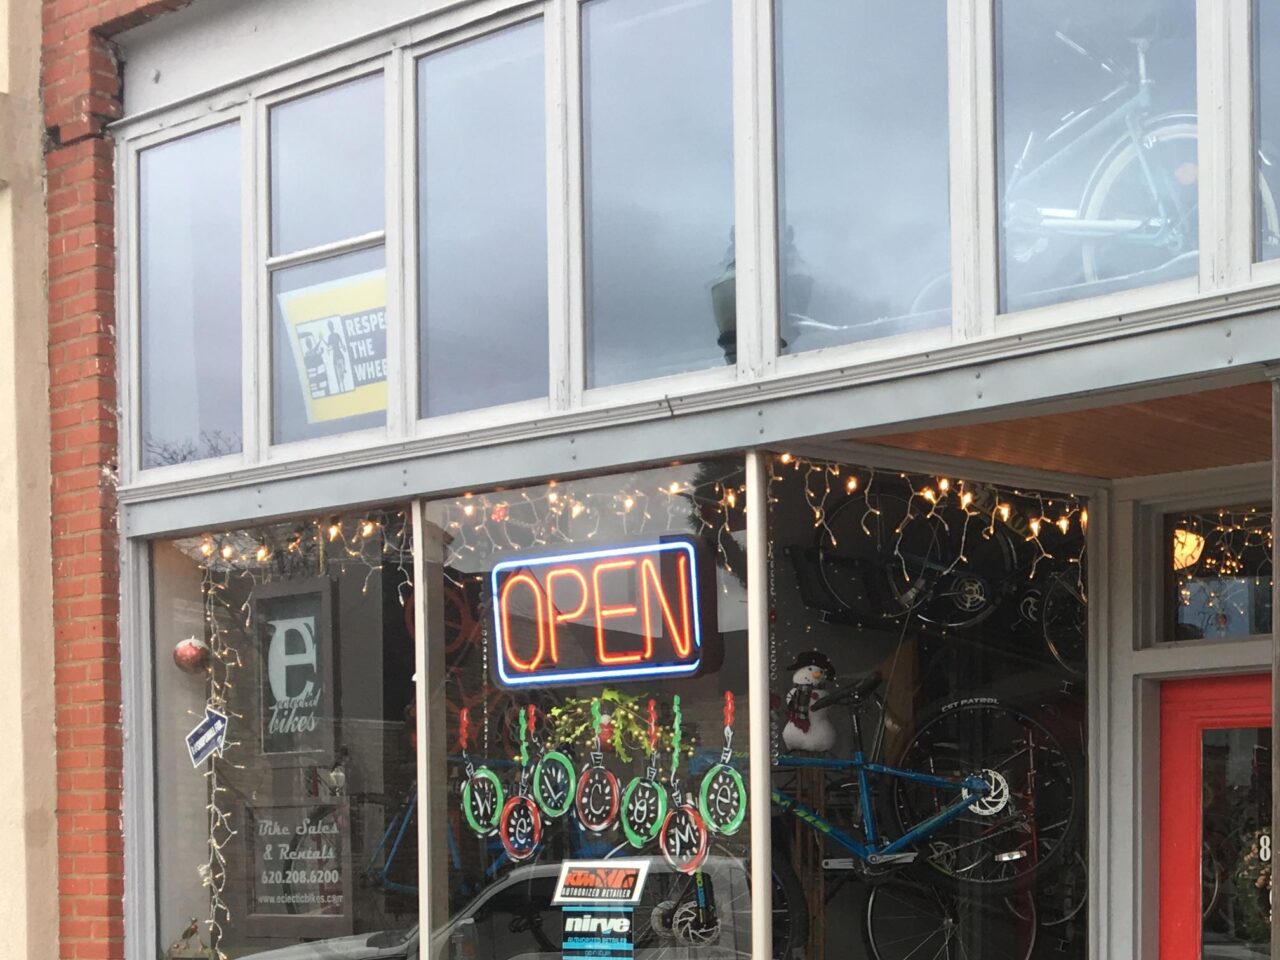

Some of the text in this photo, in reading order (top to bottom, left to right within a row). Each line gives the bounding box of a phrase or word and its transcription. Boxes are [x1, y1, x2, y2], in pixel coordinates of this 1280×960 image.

[349, 338, 375, 359] THE
[500, 556, 690, 672] OPEN
[268, 706, 319, 734] bikes
[258, 818, 340, 836] Bike Sales
[263, 843, 336, 860] & Rentals
[261, 869, 339, 884] 620.208.6200
[562, 868, 597, 888] KTM
[561, 887, 632, 898] AUTHORIZED RETAILER
[564, 914, 631, 934] nirve
